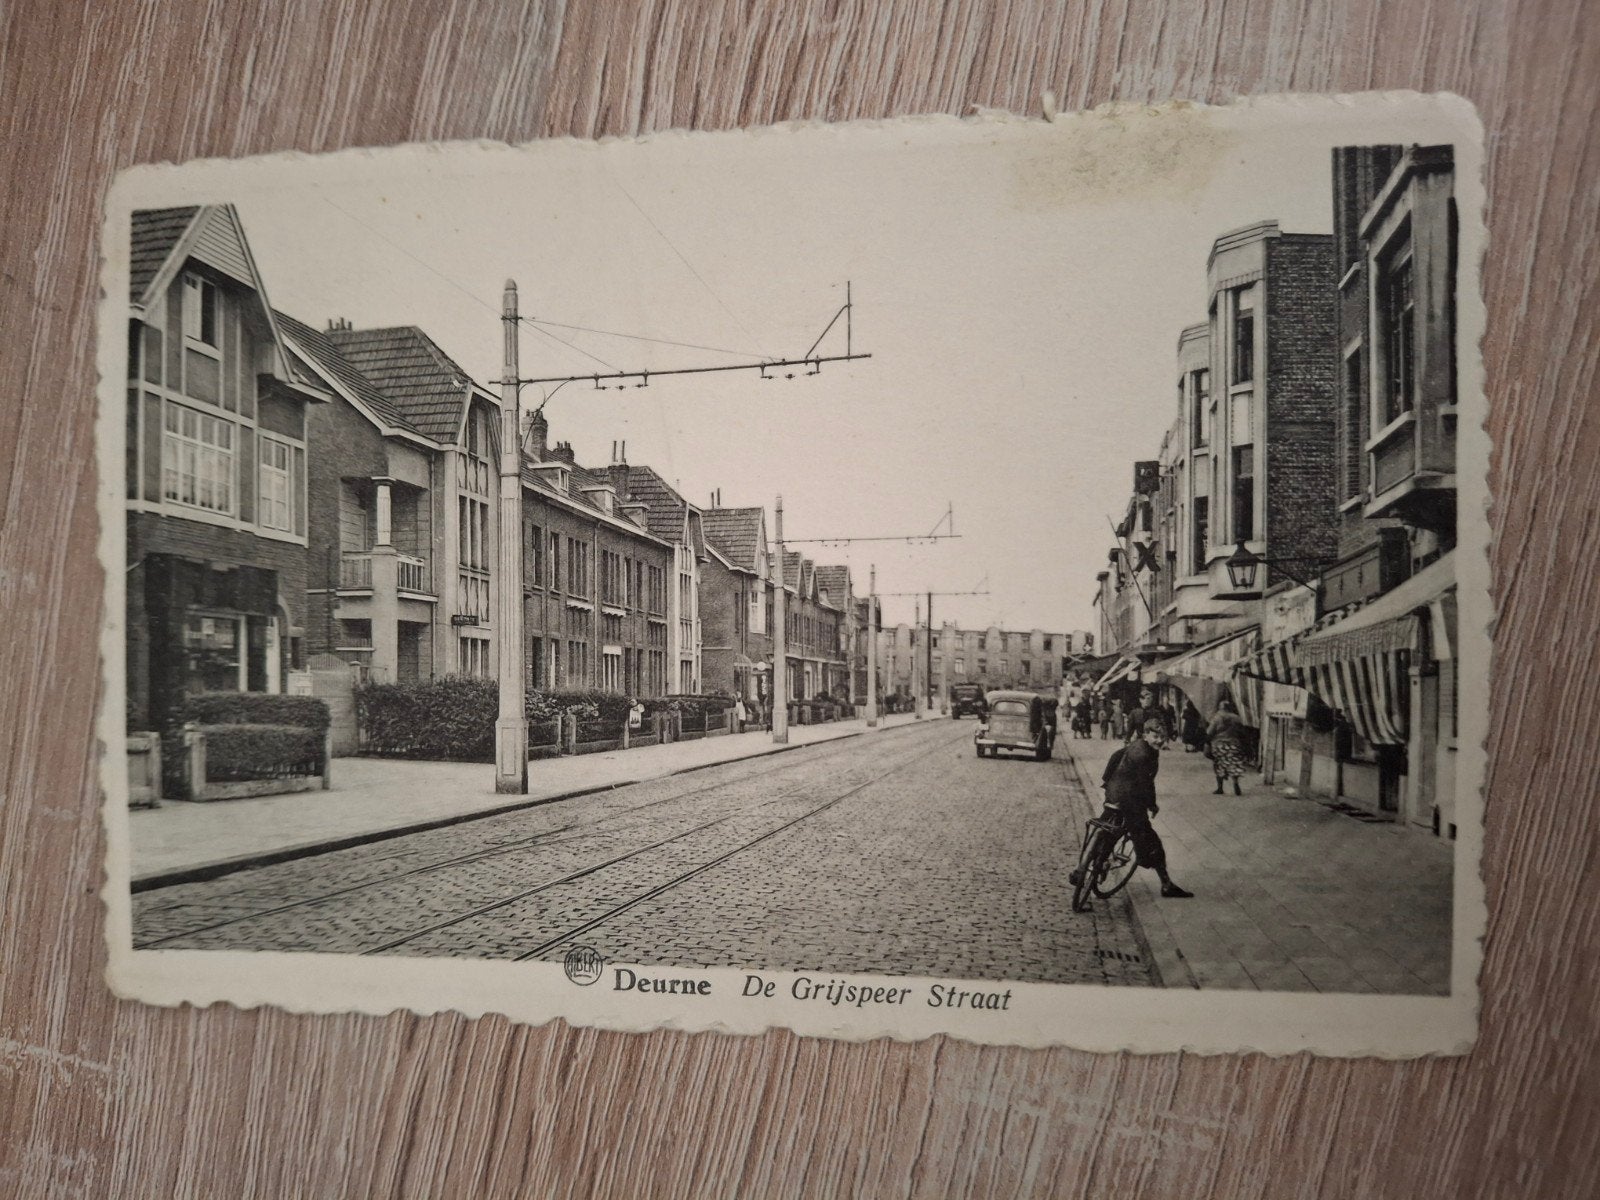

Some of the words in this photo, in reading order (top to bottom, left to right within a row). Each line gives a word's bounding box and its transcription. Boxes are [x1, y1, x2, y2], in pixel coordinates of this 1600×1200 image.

[613, 968, 712, 995] Deurne
[741, 975, 776, 998] De
[791, 977, 912, 1008] Grijspeer
[927, 984, 1013, 1011] Straat
